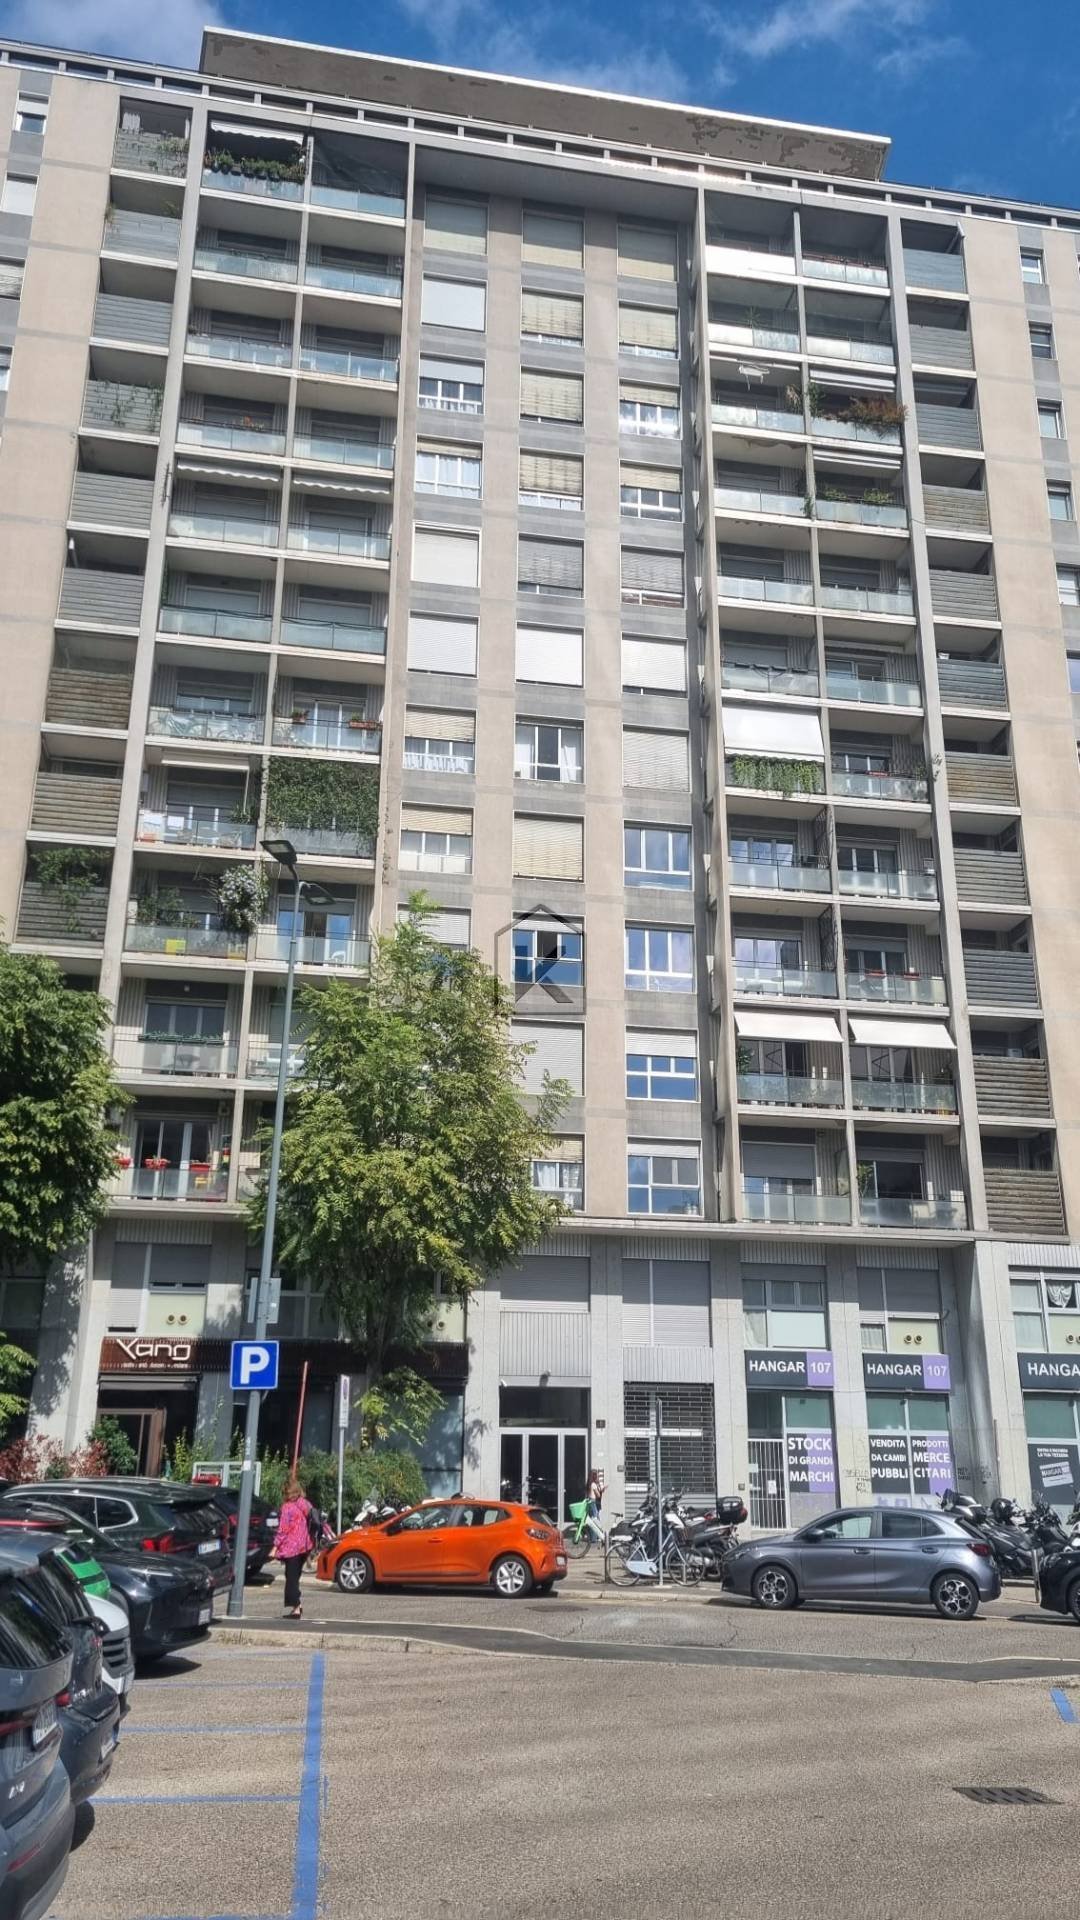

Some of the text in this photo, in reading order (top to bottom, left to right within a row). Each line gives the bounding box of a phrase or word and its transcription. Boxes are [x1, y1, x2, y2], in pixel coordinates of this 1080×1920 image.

[240, 1346, 270, 1384] P
[749, 1360, 831, 1374] HANGAR 107
[866, 1363, 947, 1377] HANGAR 107
[788, 1437, 832, 1451] STOCK
[870, 1439, 948, 1448] VENDITA PRODOTTI
[788, 1455, 833, 1465] DI GRANDI
[871, 1452, 950, 1463] DA CAMBI MERCE
[789, 1471, 834, 1482] MARCHI
[871, 1467, 908, 1478] PUBBLI
[914, 1467, 951, 1478] CITARI
